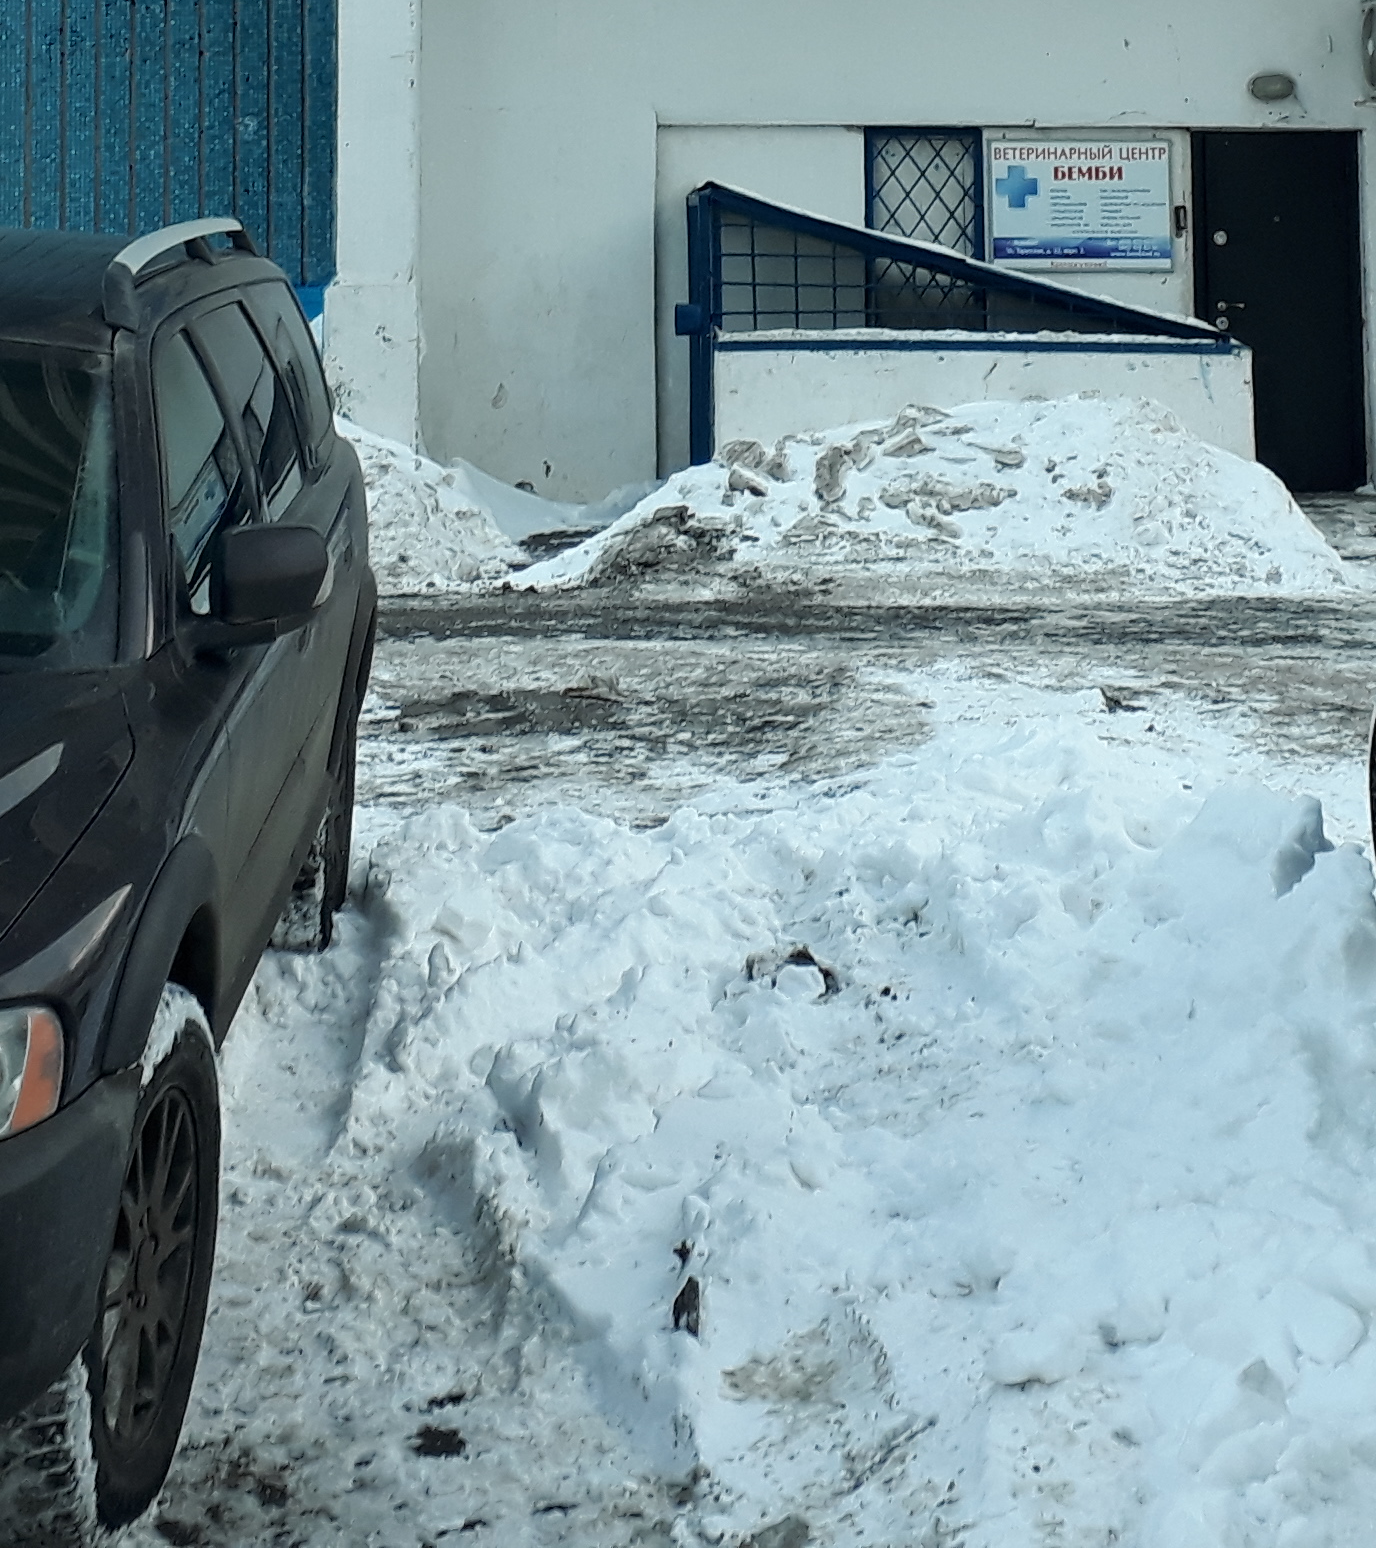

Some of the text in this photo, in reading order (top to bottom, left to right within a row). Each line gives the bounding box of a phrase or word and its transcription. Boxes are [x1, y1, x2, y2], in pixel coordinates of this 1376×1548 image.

[993, 145, 1166, 162] ВЕТЕРИНАРНЫЙ ЦЕНТР
[1053, 165, 1124, 181] БЕМБИ
